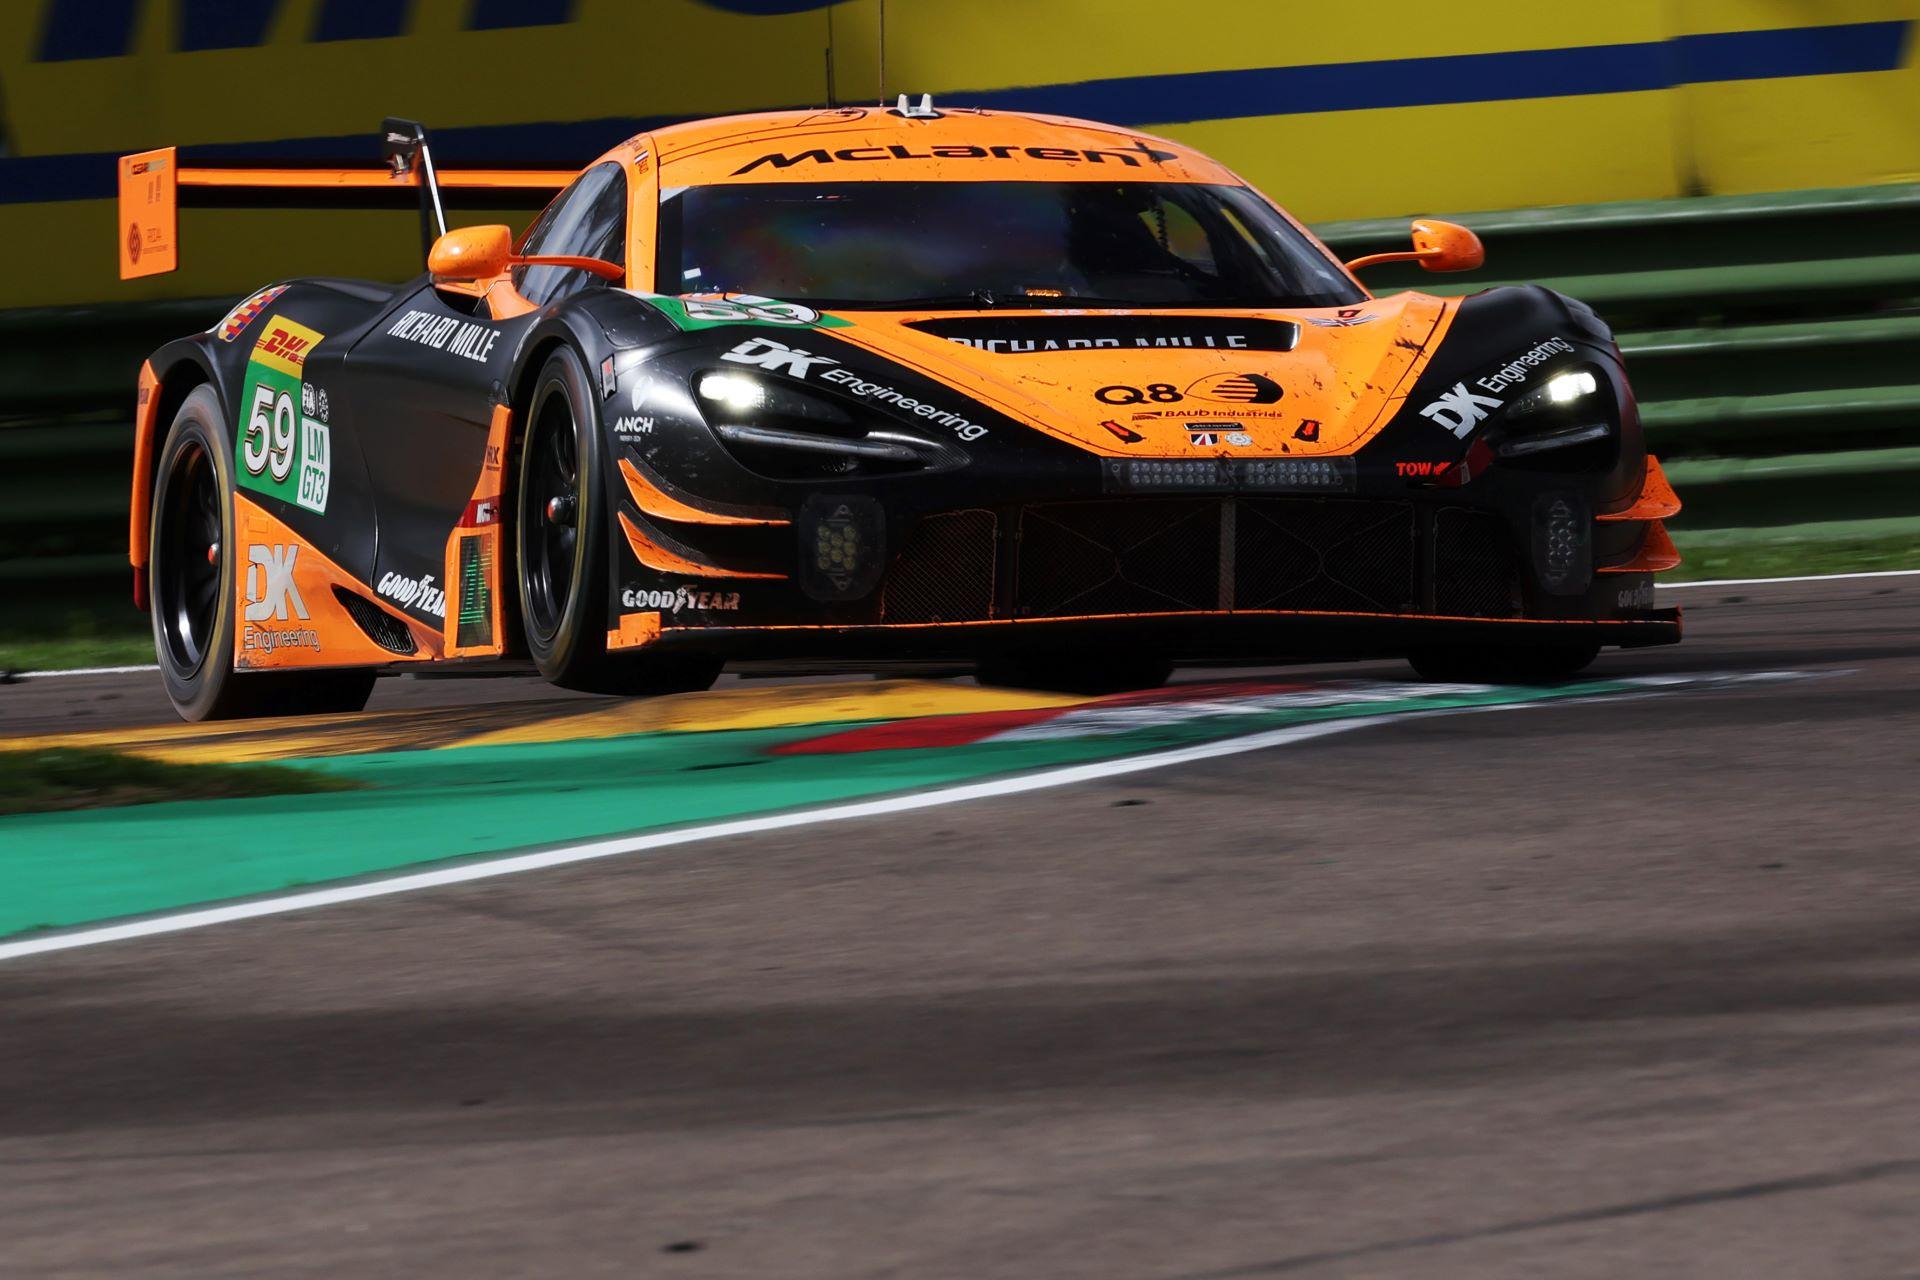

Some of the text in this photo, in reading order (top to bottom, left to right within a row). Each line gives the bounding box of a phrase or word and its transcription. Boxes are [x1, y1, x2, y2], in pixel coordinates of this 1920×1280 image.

[727, 143, 1144, 178] McLaren
[262, 328, 309, 363] DHL
[386, 310, 501, 363] RICHARD MILLE
[720, 337, 989, 442] DK Engineering
[1094, 383, 1184, 406] Q8
[1418, 336, 1575, 440] DK Engineering
[242, 383, 298, 484] 59
[613, 416, 655, 434] ANCH
[307, 426, 324, 465] LM
[302, 463, 326, 505] GT3
[1396, 462, 1431, 476] TOW
[244, 544, 310, 622] DK
[622, 588, 740, 613] GOODYEAR
[243, 625, 320, 654] Engineering
